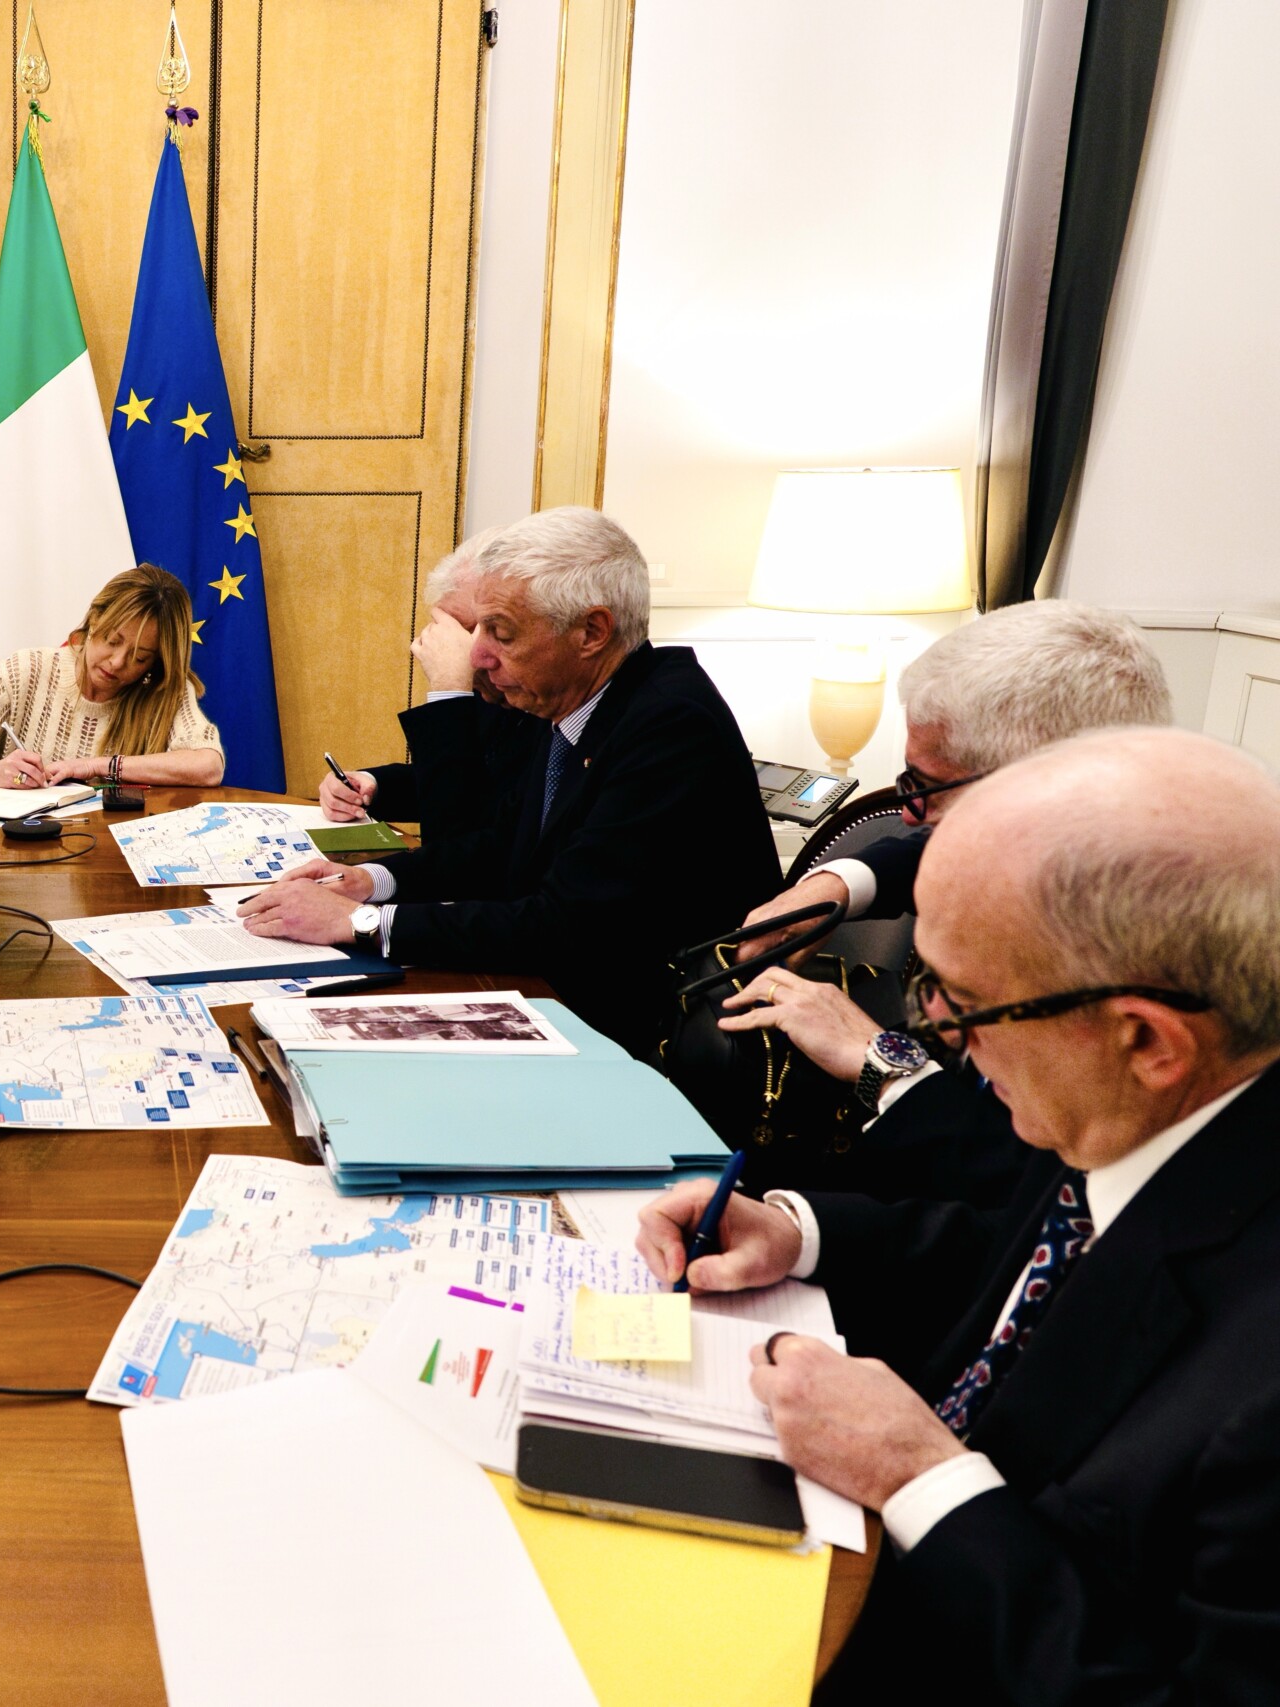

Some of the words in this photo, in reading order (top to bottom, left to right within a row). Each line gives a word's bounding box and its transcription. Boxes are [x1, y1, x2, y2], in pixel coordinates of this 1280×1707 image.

[149, 1301, 168, 1321] GOLFO
[142, 1321, 158, 1335] DEL
[132, 1334, 151, 1357] PAESI
